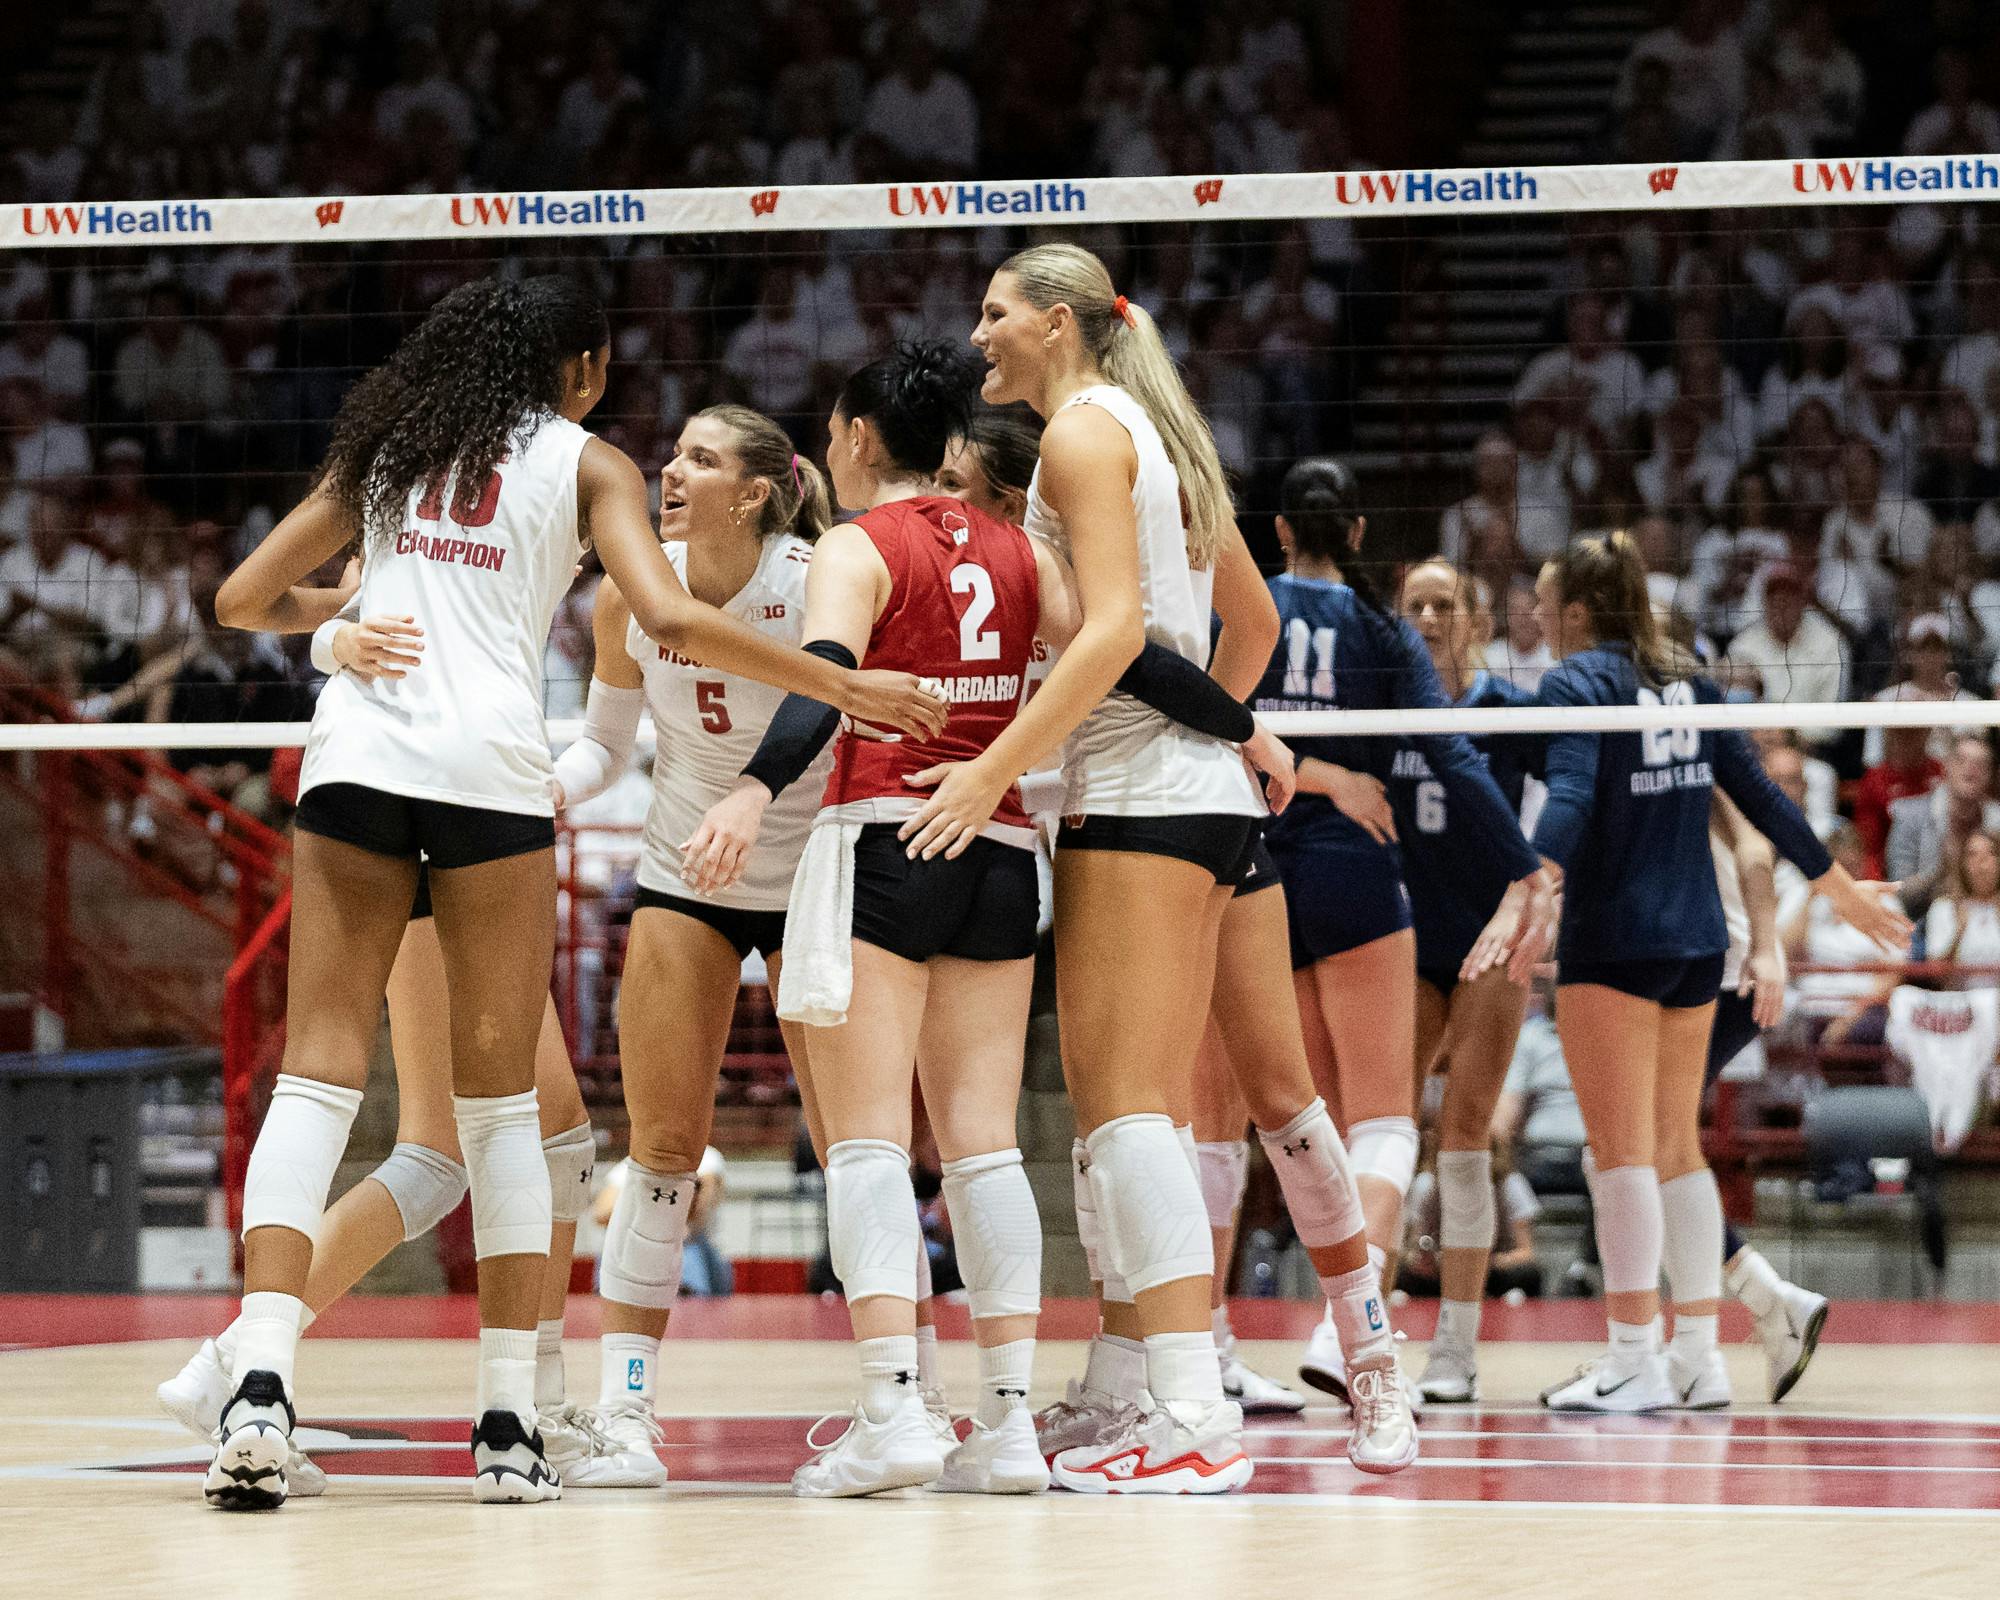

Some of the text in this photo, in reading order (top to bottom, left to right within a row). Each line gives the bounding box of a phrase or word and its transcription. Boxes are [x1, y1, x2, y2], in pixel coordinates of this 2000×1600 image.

[950, 563, 1000, 661] 2
[696, 681, 732, 734] 5
[926, 675, 1019, 703] ARDARO
[1416, 781, 1447, 833] 6
